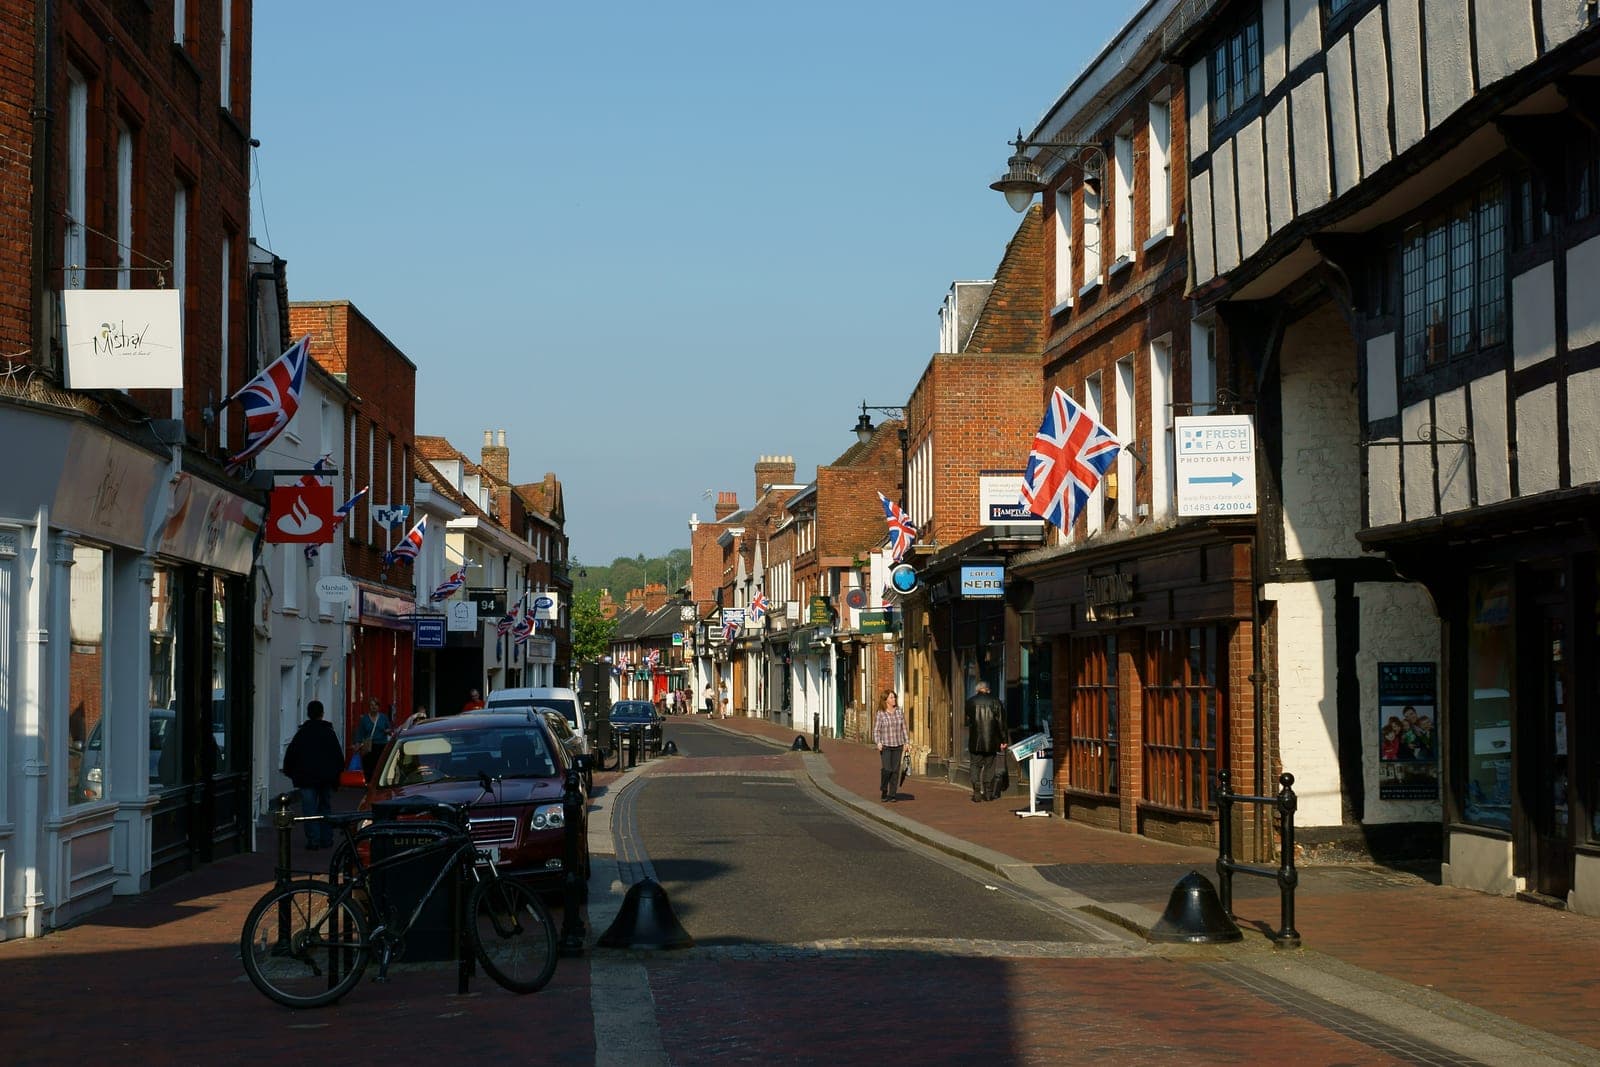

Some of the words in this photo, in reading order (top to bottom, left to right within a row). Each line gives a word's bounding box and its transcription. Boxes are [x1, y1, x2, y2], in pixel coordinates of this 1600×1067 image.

[93, 320, 149, 355] Mistral
[1206, 429, 1247, 438] FRESH
[1206, 440, 1247, 449] FACE
[1183, 503, 1211, 512] 01483
[1213, 502, 1252, 511] 420004
[964, 580, 1003, 589] NERO
[481, 600, 496, 611] 94
